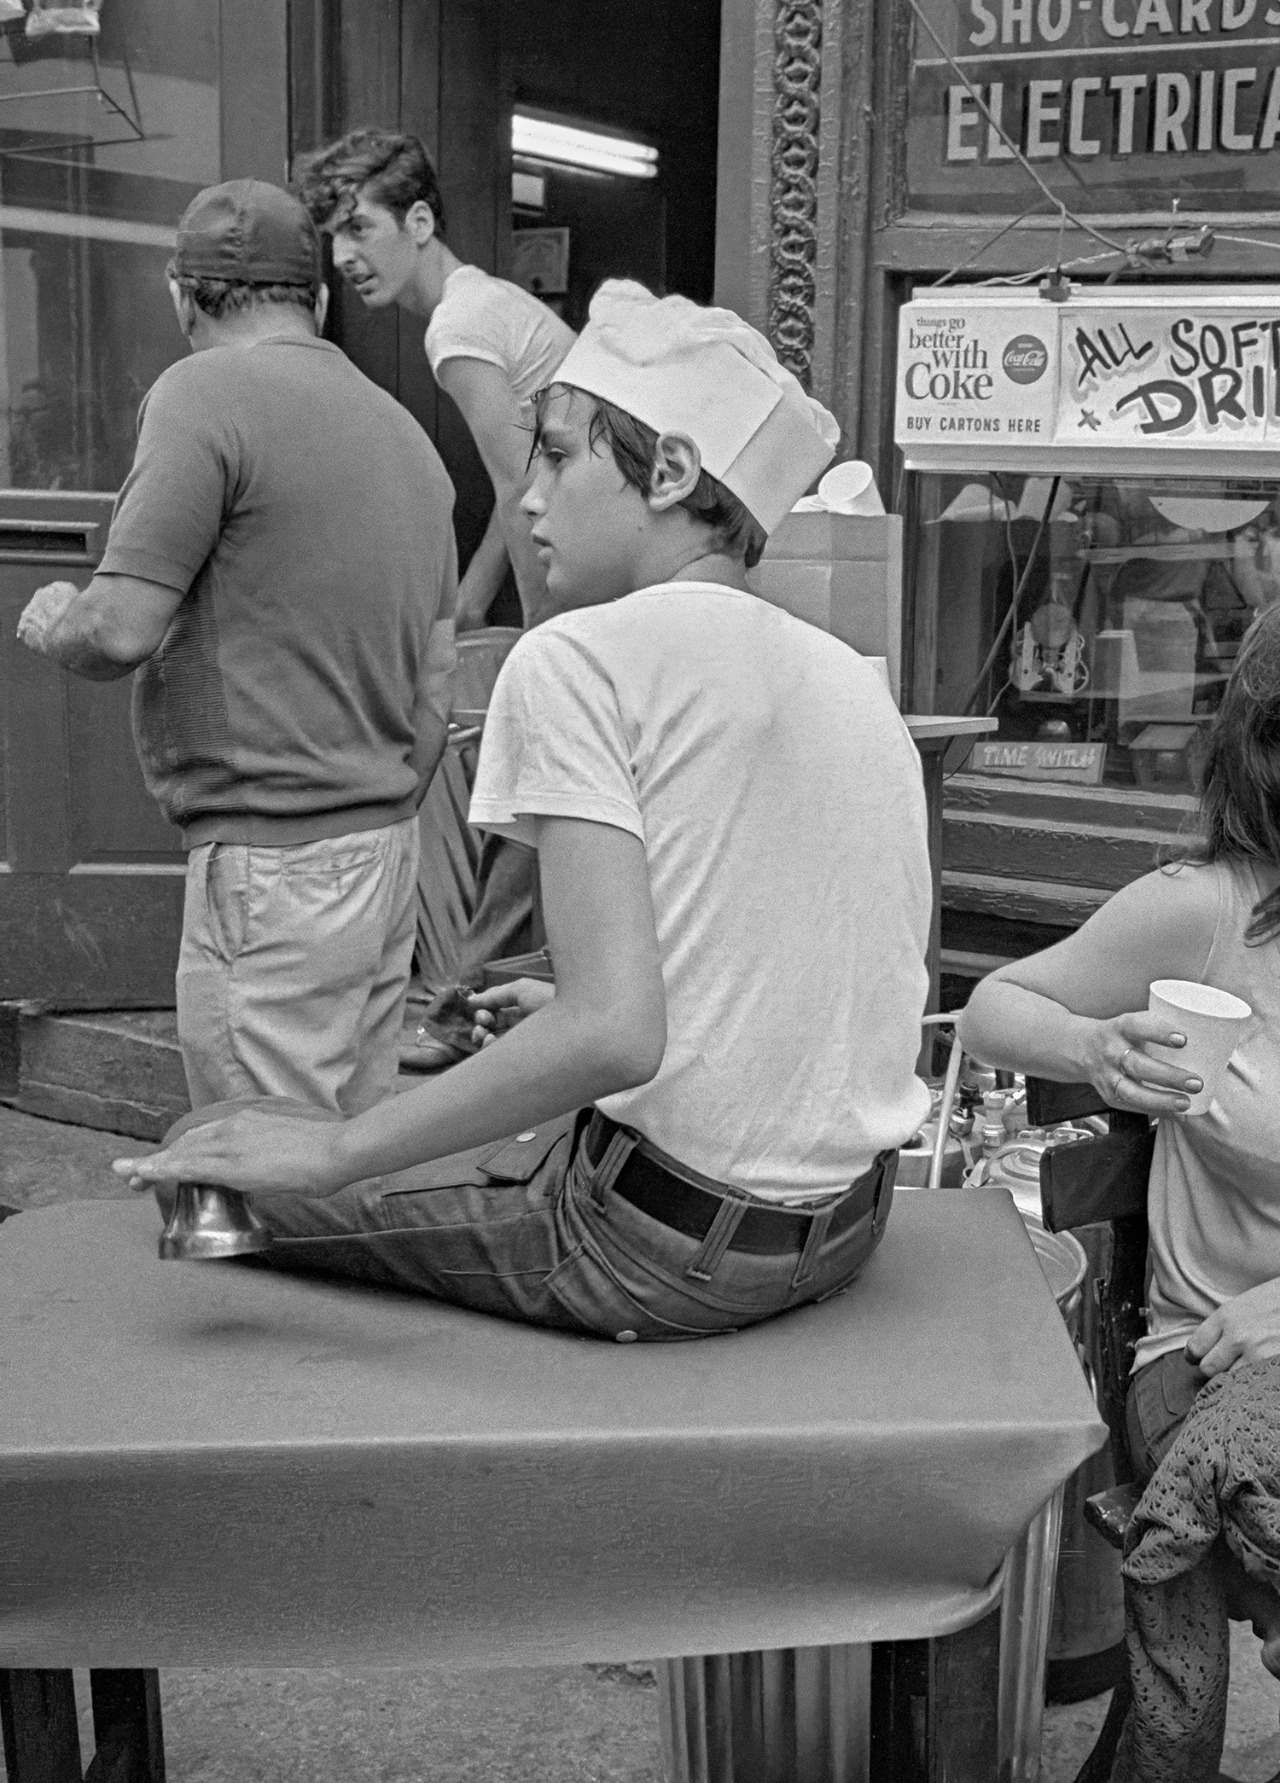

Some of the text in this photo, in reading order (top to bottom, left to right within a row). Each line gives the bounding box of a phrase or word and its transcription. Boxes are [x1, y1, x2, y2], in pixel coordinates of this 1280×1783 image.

[908, 327, 965, 349] better
[947, 317, 967, 333] go
[931, 338, 989, 370] with
[1074, 322, 1154, 387] ALL
[904, 361, 994, 401] Coke
[906, 415, 1042, 433] BUY CARTONS HERE
